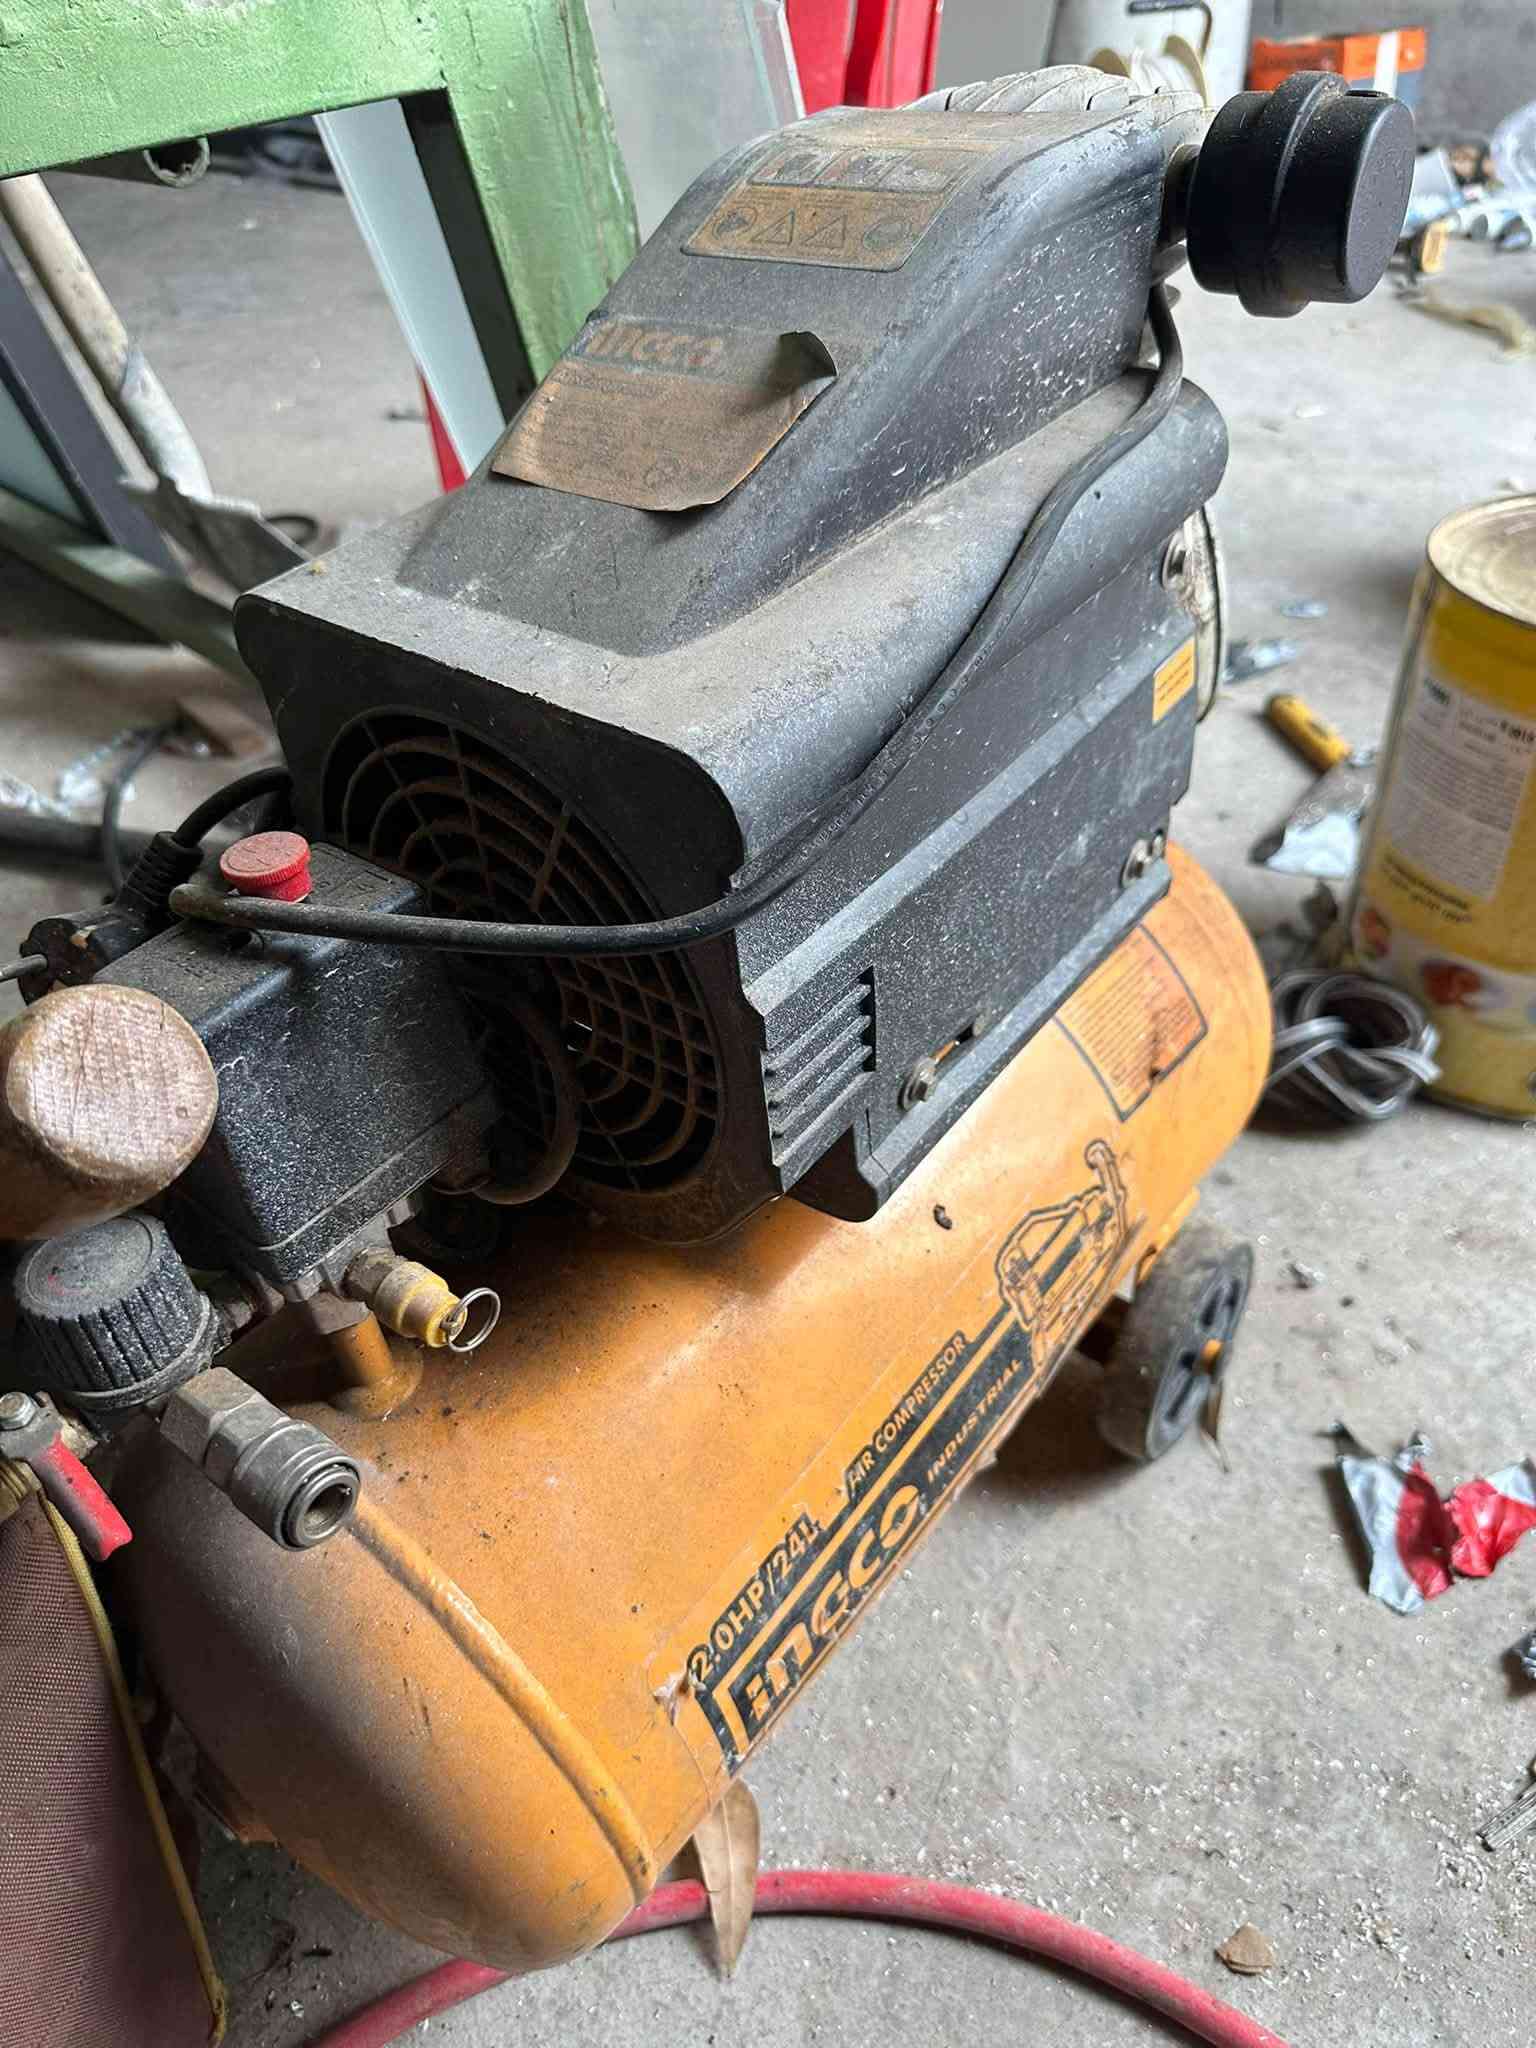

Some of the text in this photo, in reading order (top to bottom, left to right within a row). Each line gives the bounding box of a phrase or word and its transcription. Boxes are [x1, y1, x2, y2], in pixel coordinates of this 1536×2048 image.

[691, 1335, 966, 1681] 2.0HP/24L AIR COMPRESSOR
[927, 1360, 1021, 1482] INDUSTRIAL
